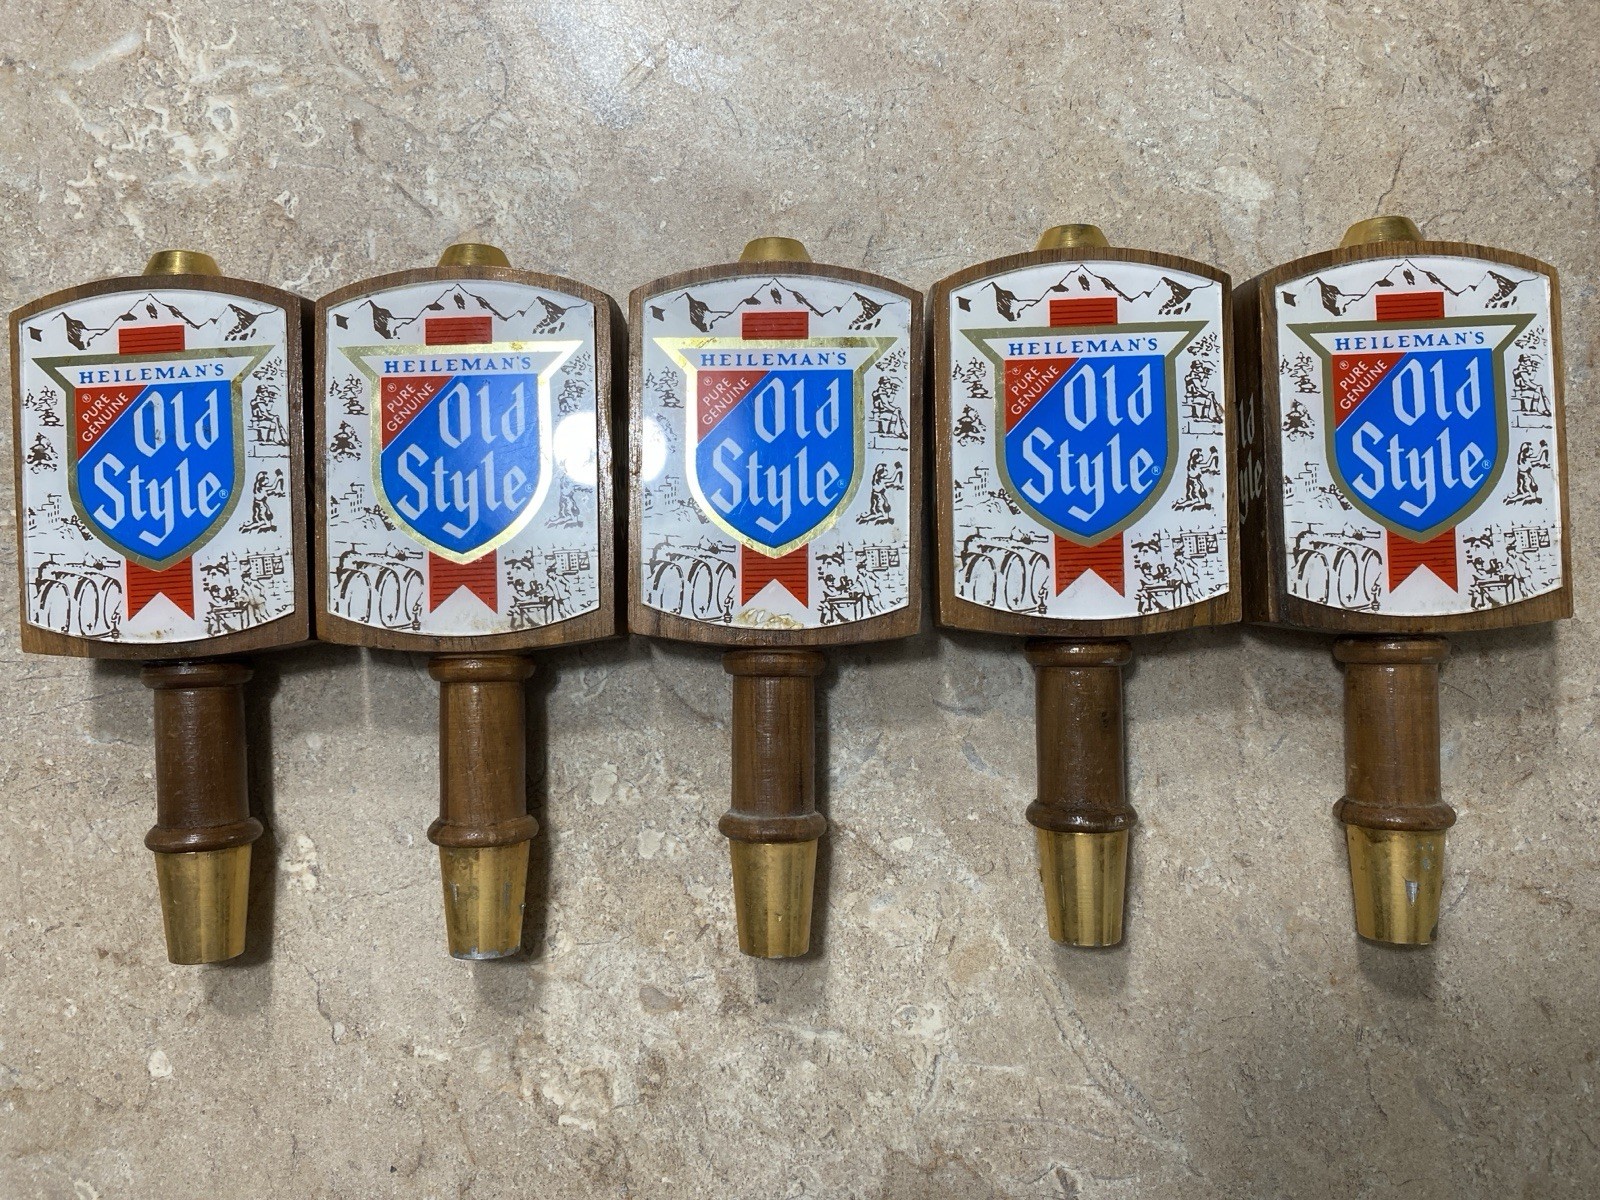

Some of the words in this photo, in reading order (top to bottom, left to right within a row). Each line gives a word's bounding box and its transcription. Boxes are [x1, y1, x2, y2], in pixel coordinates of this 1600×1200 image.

[384, 357, 531, 373] HEILEMAN'S
[701, 352, 848, 366] HEILEMAN'S
[1009, 338, 1158, 356] HEILEMAN'S
[1336, 331, 1485, 350] HEILEMAN'S
[79, 364, 224, 384] HEILEMAN'S
[387, 382, 416, 413] PURE
[703, 376, 732, 406] PURE
[1010, 365, 1040, 396] PURE
[1010, 364, 1060, 415] GENUINE
[1064, 363, 1152, 431] Old
[1340, 360, 1368, 391] PURE
[1340, 359, 1388, 410] GENUINE
[1392, 358, 1481, 425] Old
[81, 392, 111, 423] PURE
[82, 392, 129, 442] GENUINE
[133, 389, 219, 458] Old
[386, 382, 434, 432] GENUINE
[439, 383, 526, 447] Old
[702, 376, 751, 425] GENUINE
[754, 377, 839, 443] Old
[1239, 392, 1255, 448] ld
